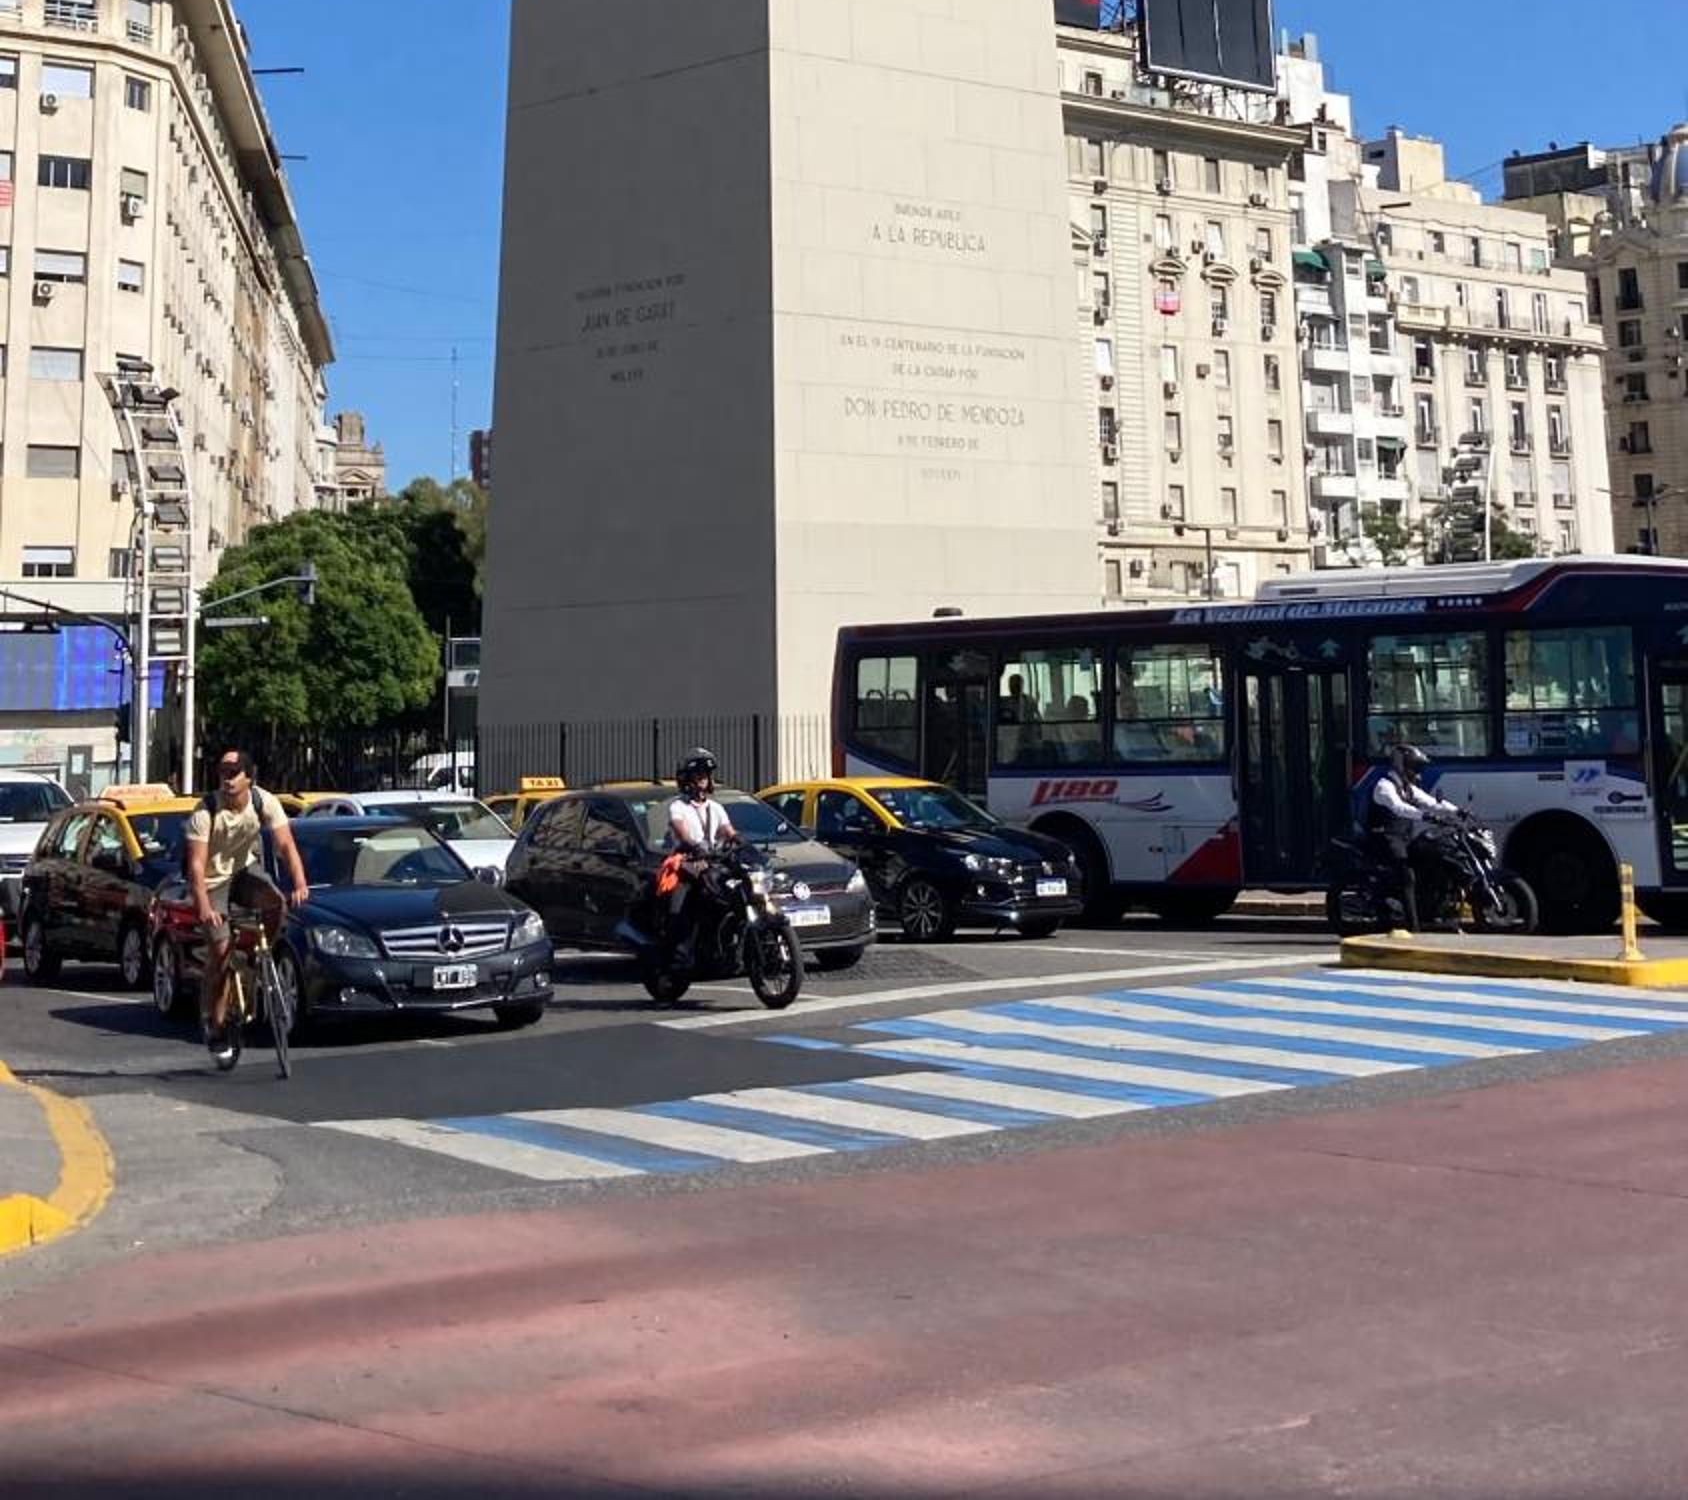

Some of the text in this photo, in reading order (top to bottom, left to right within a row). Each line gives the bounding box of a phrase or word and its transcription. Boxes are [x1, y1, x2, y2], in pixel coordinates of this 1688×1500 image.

[872, 223, 882, 241] A
[887, 226, 906, 243] LA
[615, 308, 632, 327] DE
[844, 396, 1025, 427] DON PEDRO DE MENDOZA
[1170, 598, 1427, 624] La Vecinal de Matanza
